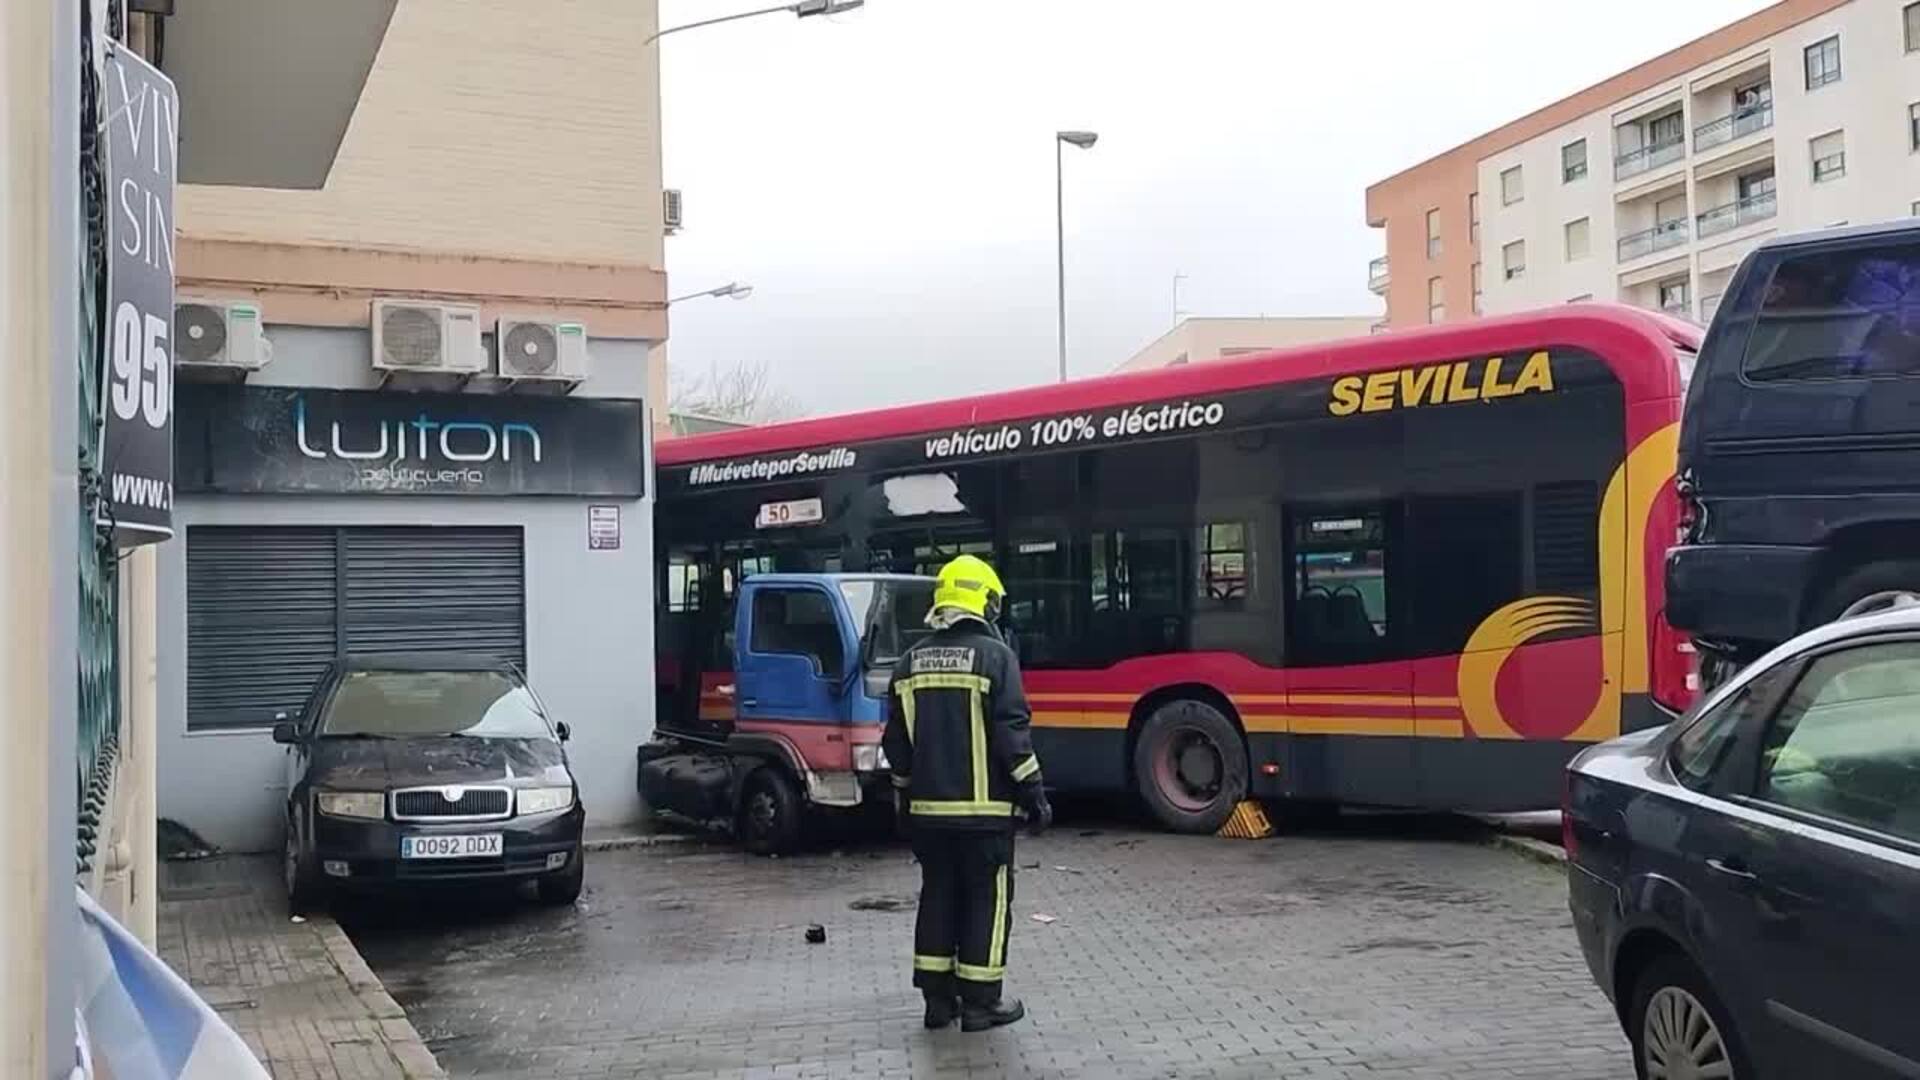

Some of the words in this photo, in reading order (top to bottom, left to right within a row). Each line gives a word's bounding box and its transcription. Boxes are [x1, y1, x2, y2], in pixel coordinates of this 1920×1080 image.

[112, 301, 168, 428] 95
[1329, 351, 1554, 416] SEVILLA
[925, 425, 1021, 458] vehículo
[1030, 415, 1096, 446] 100%
[1103, 402, 1223, 437] eléctrico
[689, 447, 857, 485] #MuéveteporSevilla
[769, 504, 790, 521] 50
[416, 838, 460, 854] 0092
[466, 836, 498, 853] DDX
